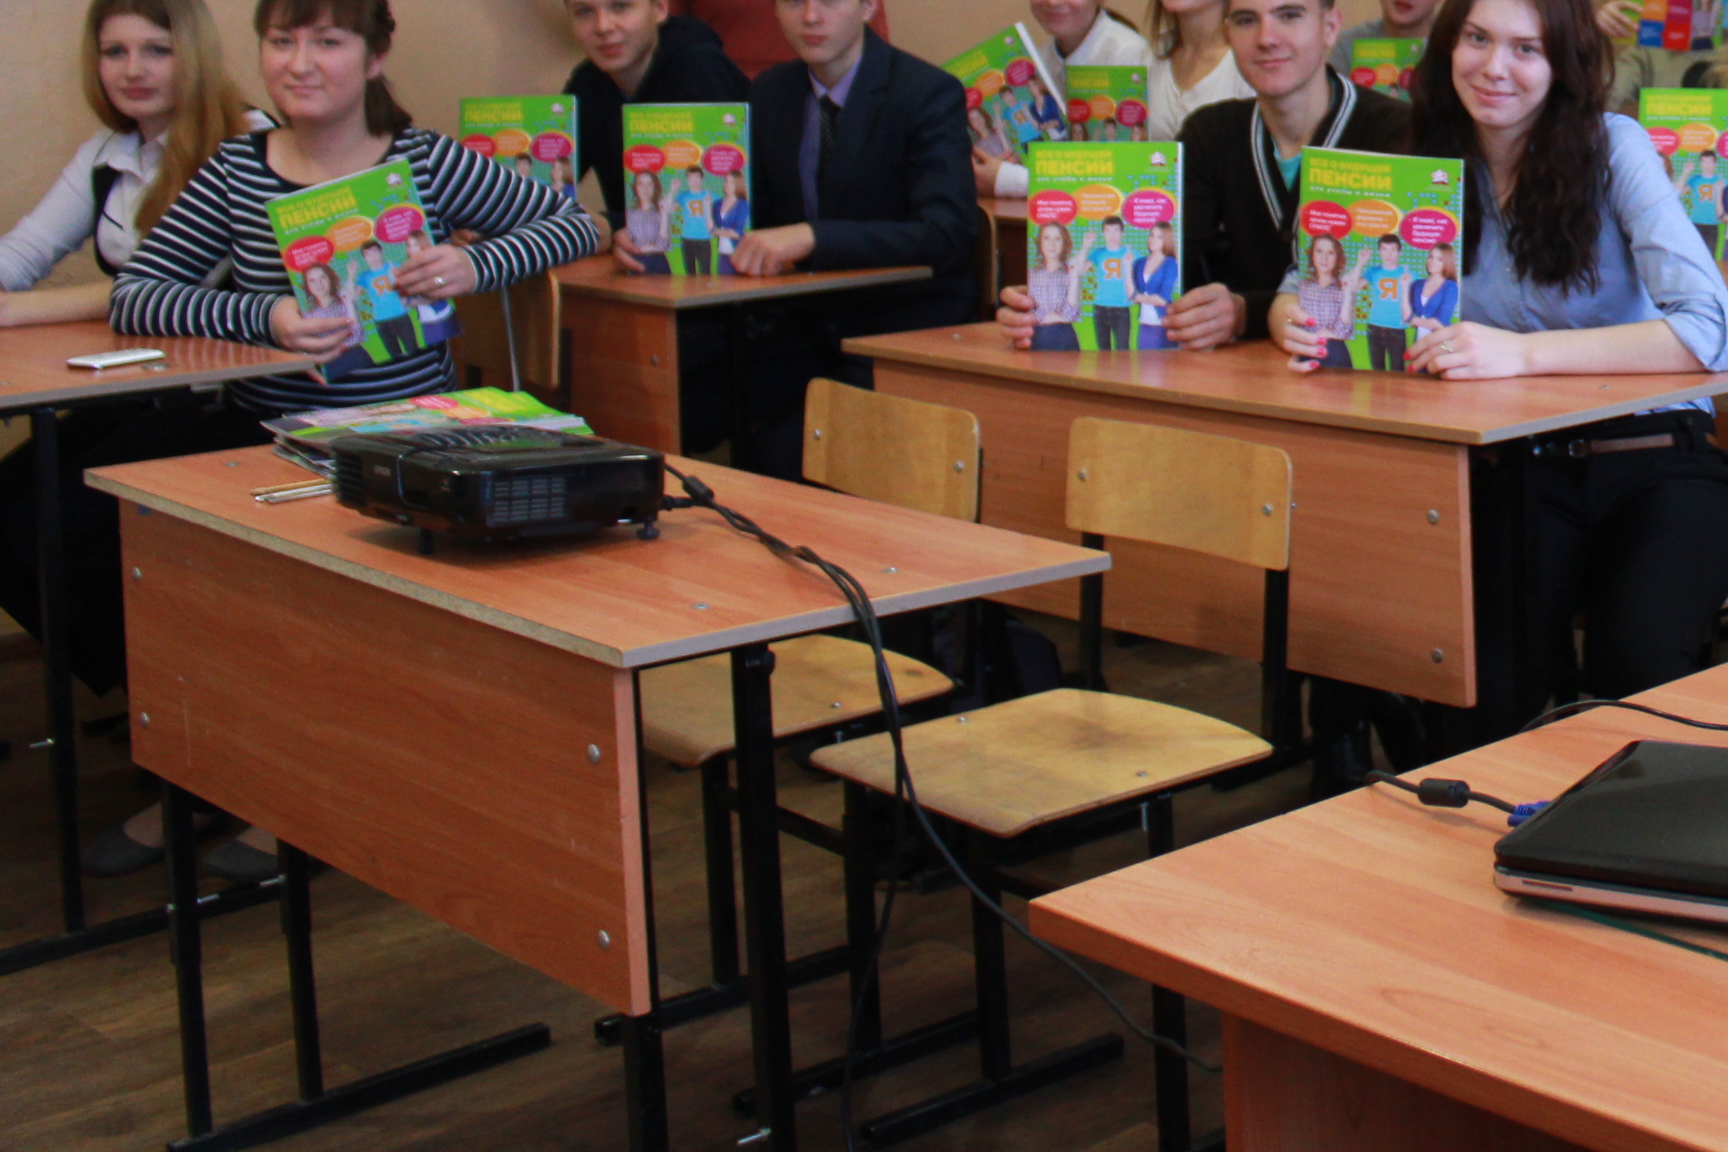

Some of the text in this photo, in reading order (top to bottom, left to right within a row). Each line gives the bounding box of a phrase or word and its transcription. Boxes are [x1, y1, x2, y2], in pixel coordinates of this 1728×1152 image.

[1036, 160, 1114, 176] ПЕНСИИ
[1309, 167, 1392, 191] ПЕНСИИ
[279, 194, 357, 229] ПЕНСИИ
[1103, 259, 1122, 279] Я
[372, 275, 393, 296] Я
[1378, 278, 1398, 300] Я
